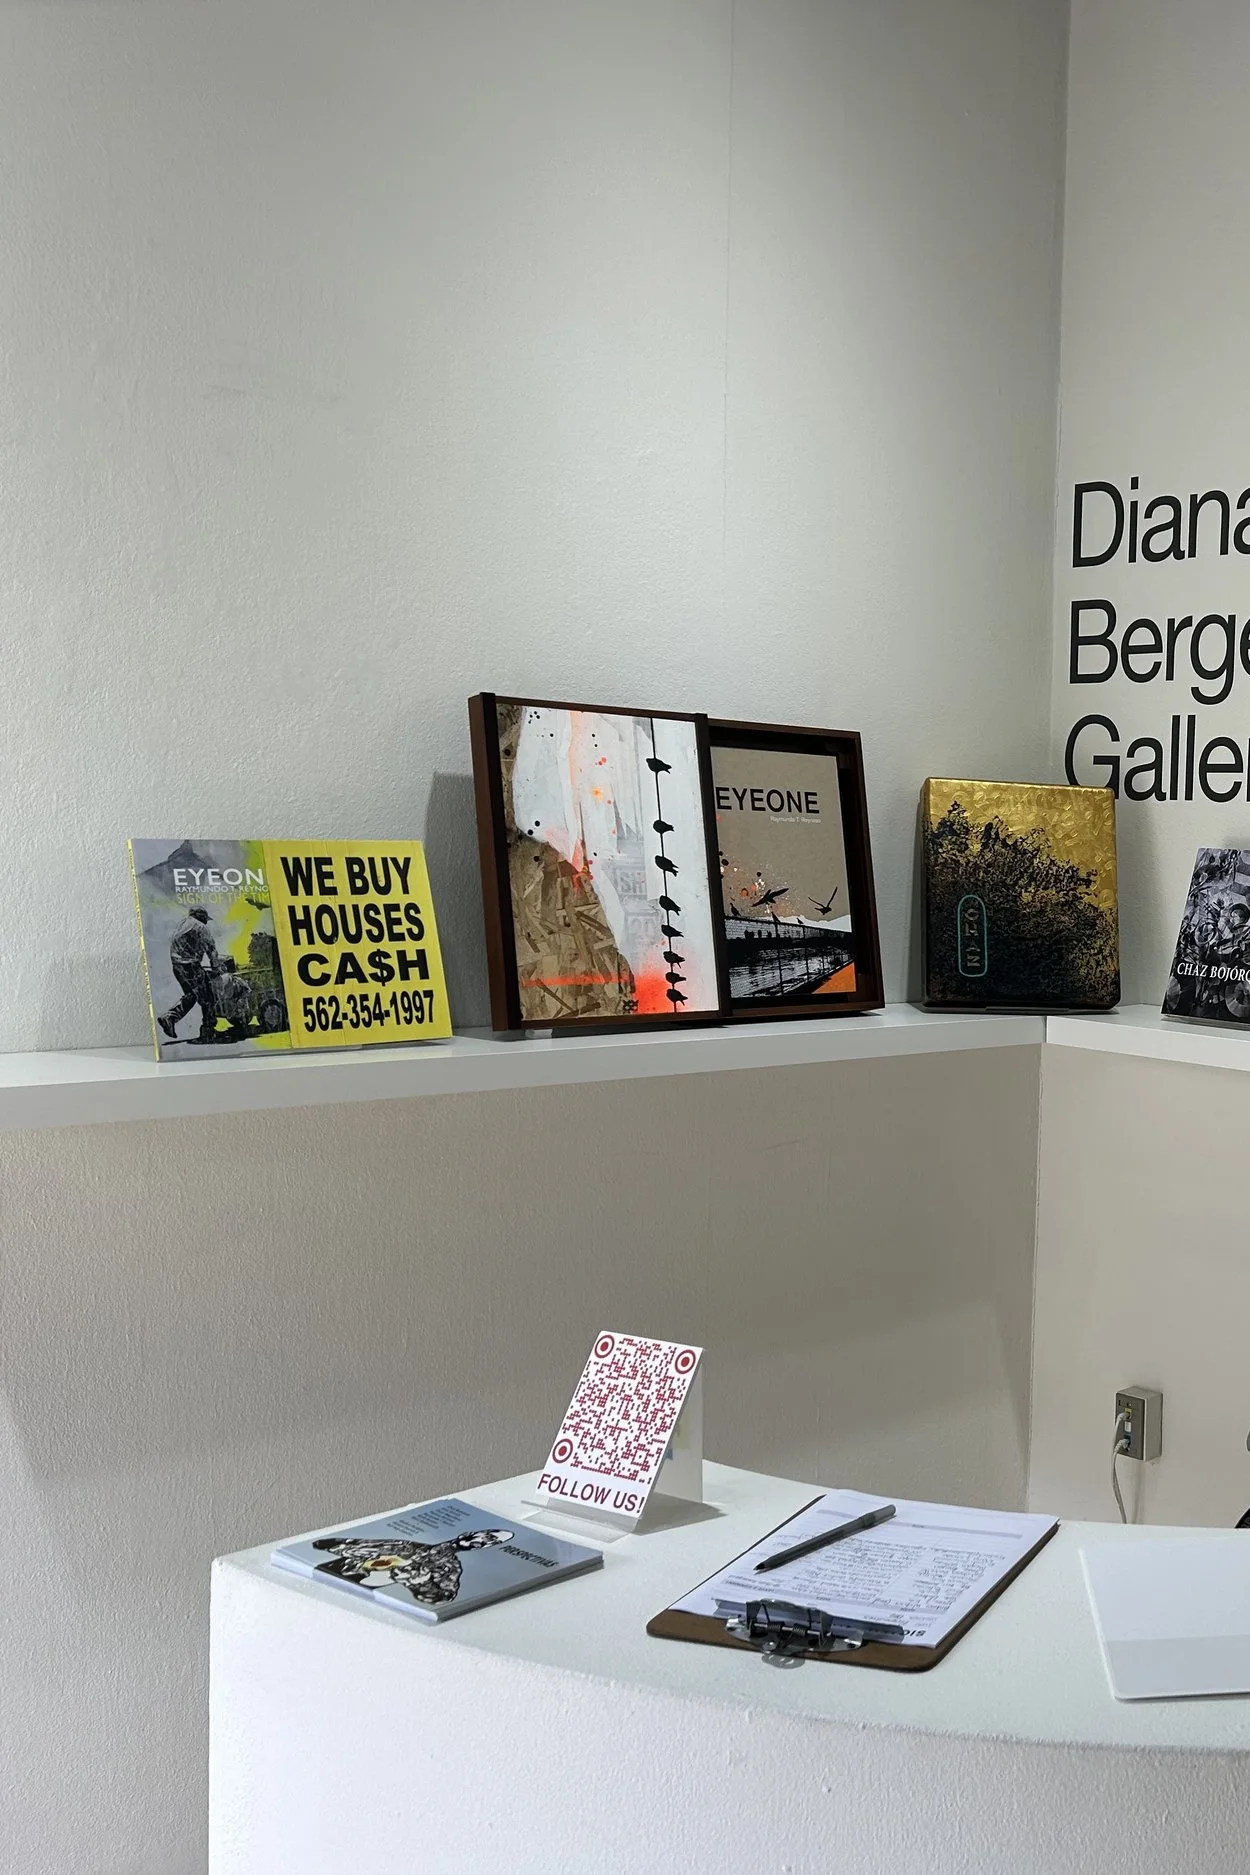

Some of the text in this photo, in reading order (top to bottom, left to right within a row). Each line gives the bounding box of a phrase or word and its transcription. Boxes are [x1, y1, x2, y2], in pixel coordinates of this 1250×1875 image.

[715, 786, 820, 814] EYEONE
[173, 868, 265, 886] EYEON
[175, 885, 229, 893] RAYMUNDO
[280, 856, 412, 897] WE BUY
[176, 892, 204, 904] SIGN
[208, 892, 225, 904] OF
[288, 902, 425, 946] HOUSES
[297, 948, 430, 988] CA$H
[1177, 962, 1209, 977] CHAZ
[302, 990, 435, 1034] 562-354-1997
[537, 1473, 645, 1514] FOLLOW US!
